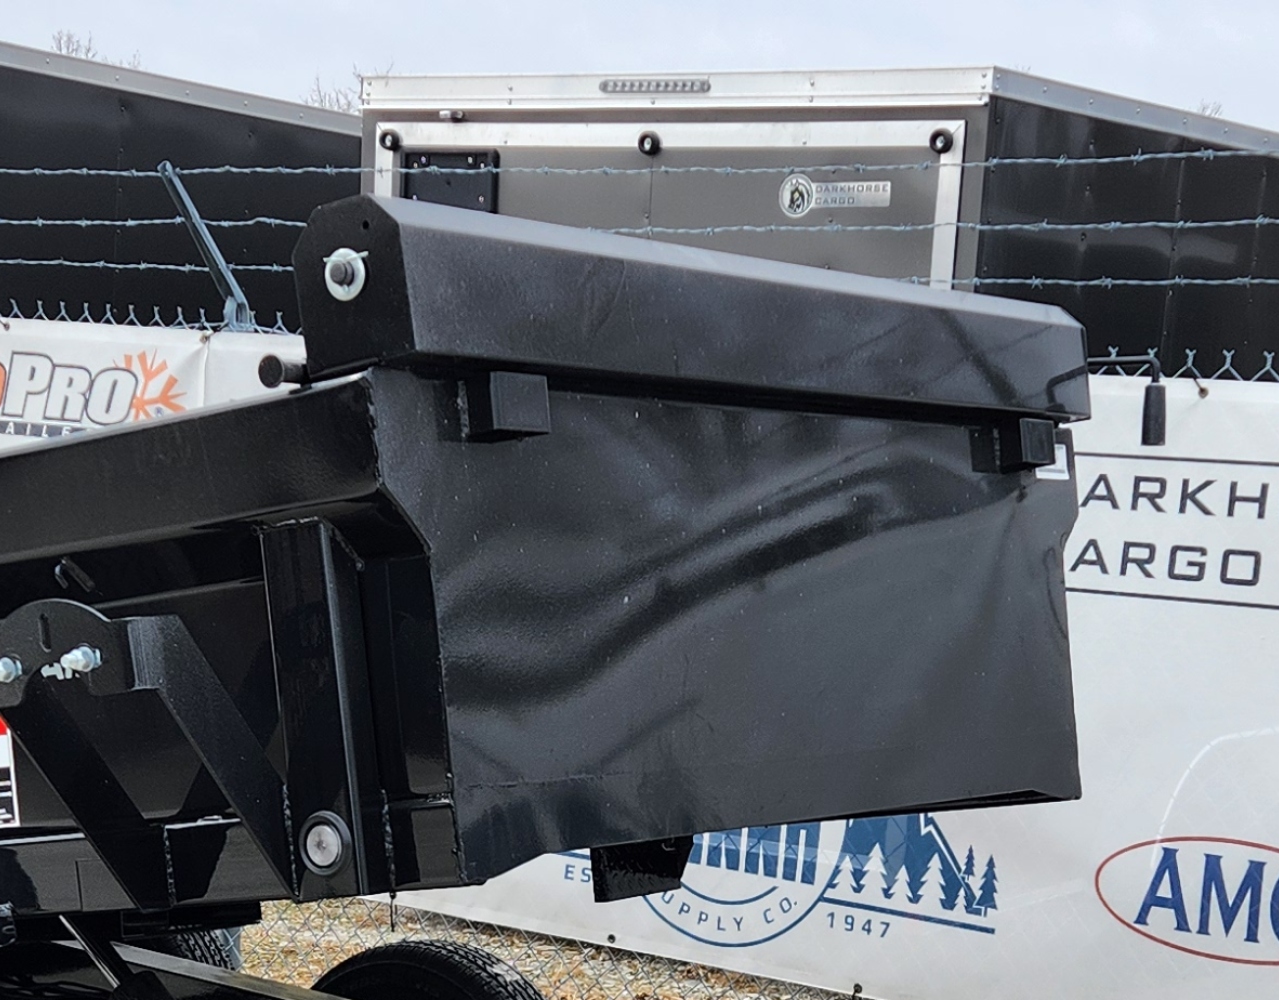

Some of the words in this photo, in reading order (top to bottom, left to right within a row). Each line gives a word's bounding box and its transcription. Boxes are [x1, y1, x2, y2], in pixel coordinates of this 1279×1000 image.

[815, 184, 889, 194] DARKHORSE
[814, 197, 855, 205] CARGO
[1069, 538, 1262, 587] ARGO
[563, 863, 593, 883] ES
[661, 892, 744, 931] UPPLY
[762, 896, 798, 924] CO.
[826, 911, 891, 938] 1947
